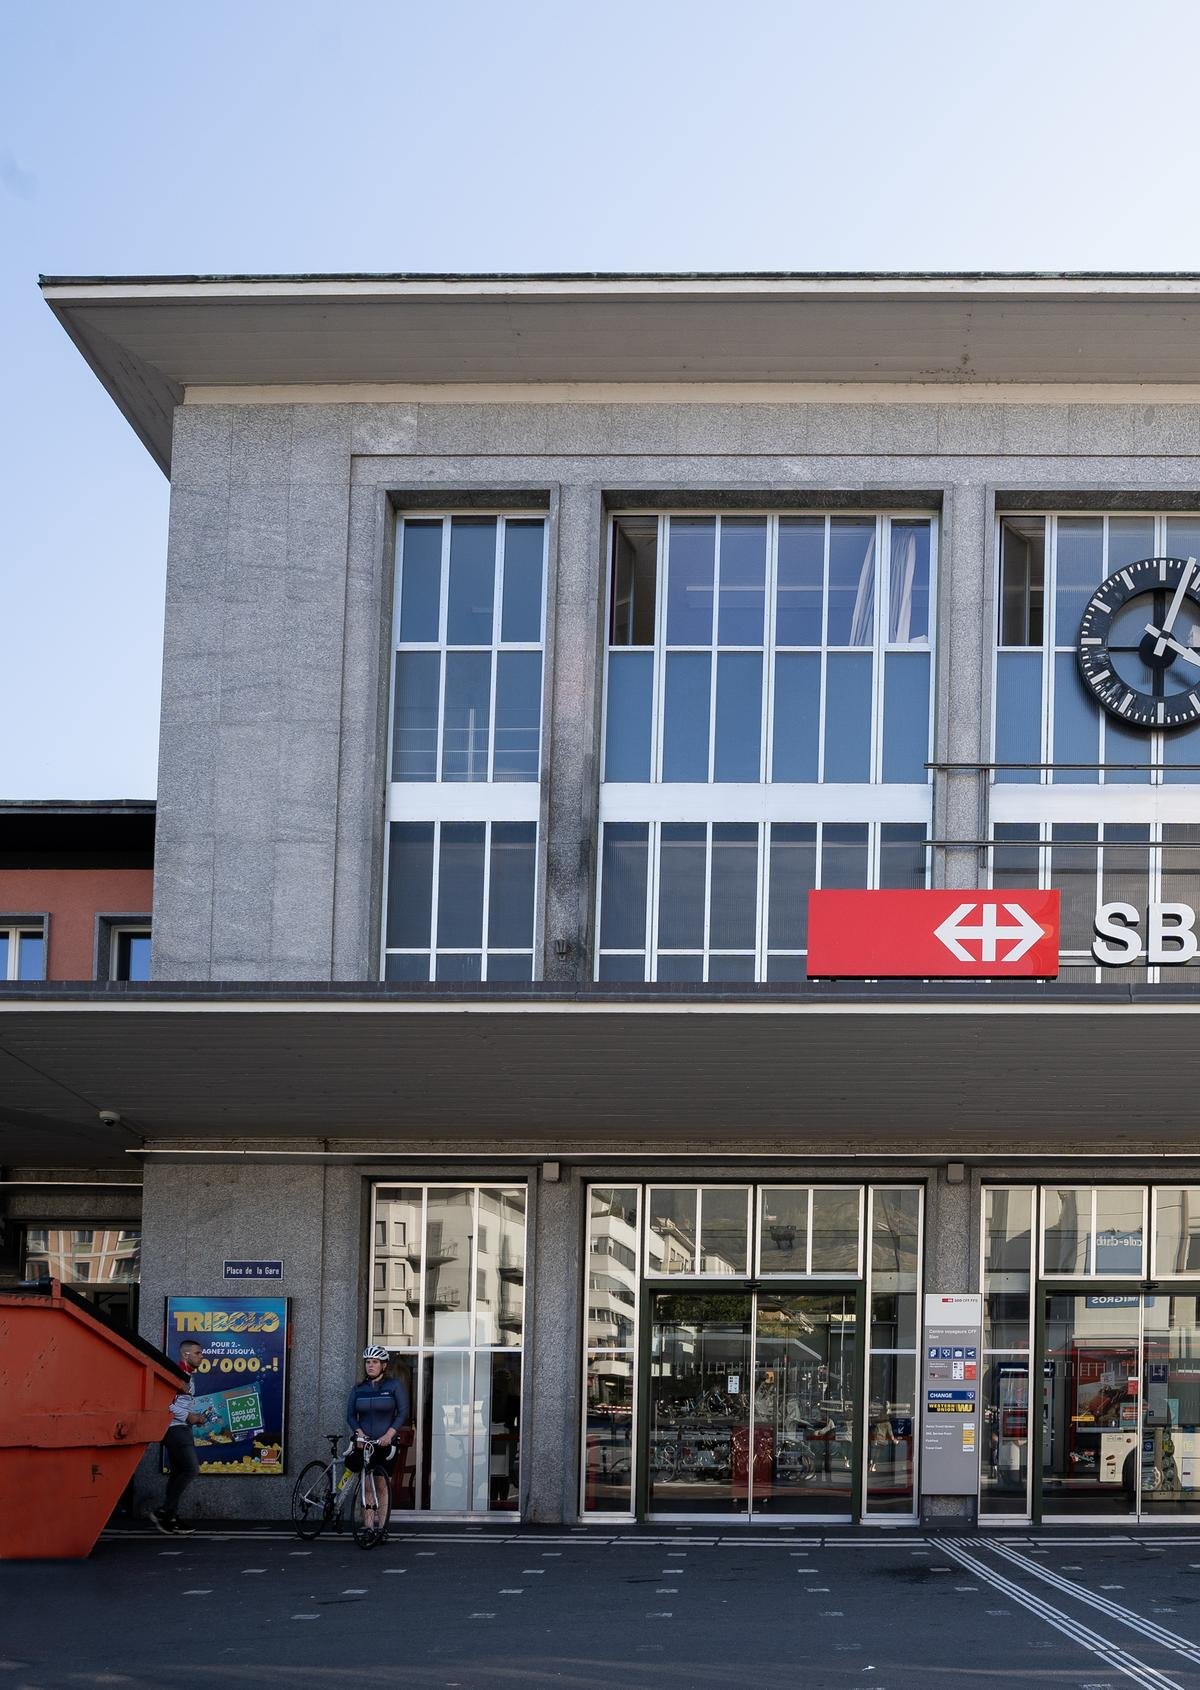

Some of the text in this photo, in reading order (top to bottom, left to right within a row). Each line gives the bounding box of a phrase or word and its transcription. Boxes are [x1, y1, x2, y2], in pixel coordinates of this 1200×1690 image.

[226, 1266, 280, 1275] Place de la Gare
[173, 1311, 280, 1333] TRIBOLO
